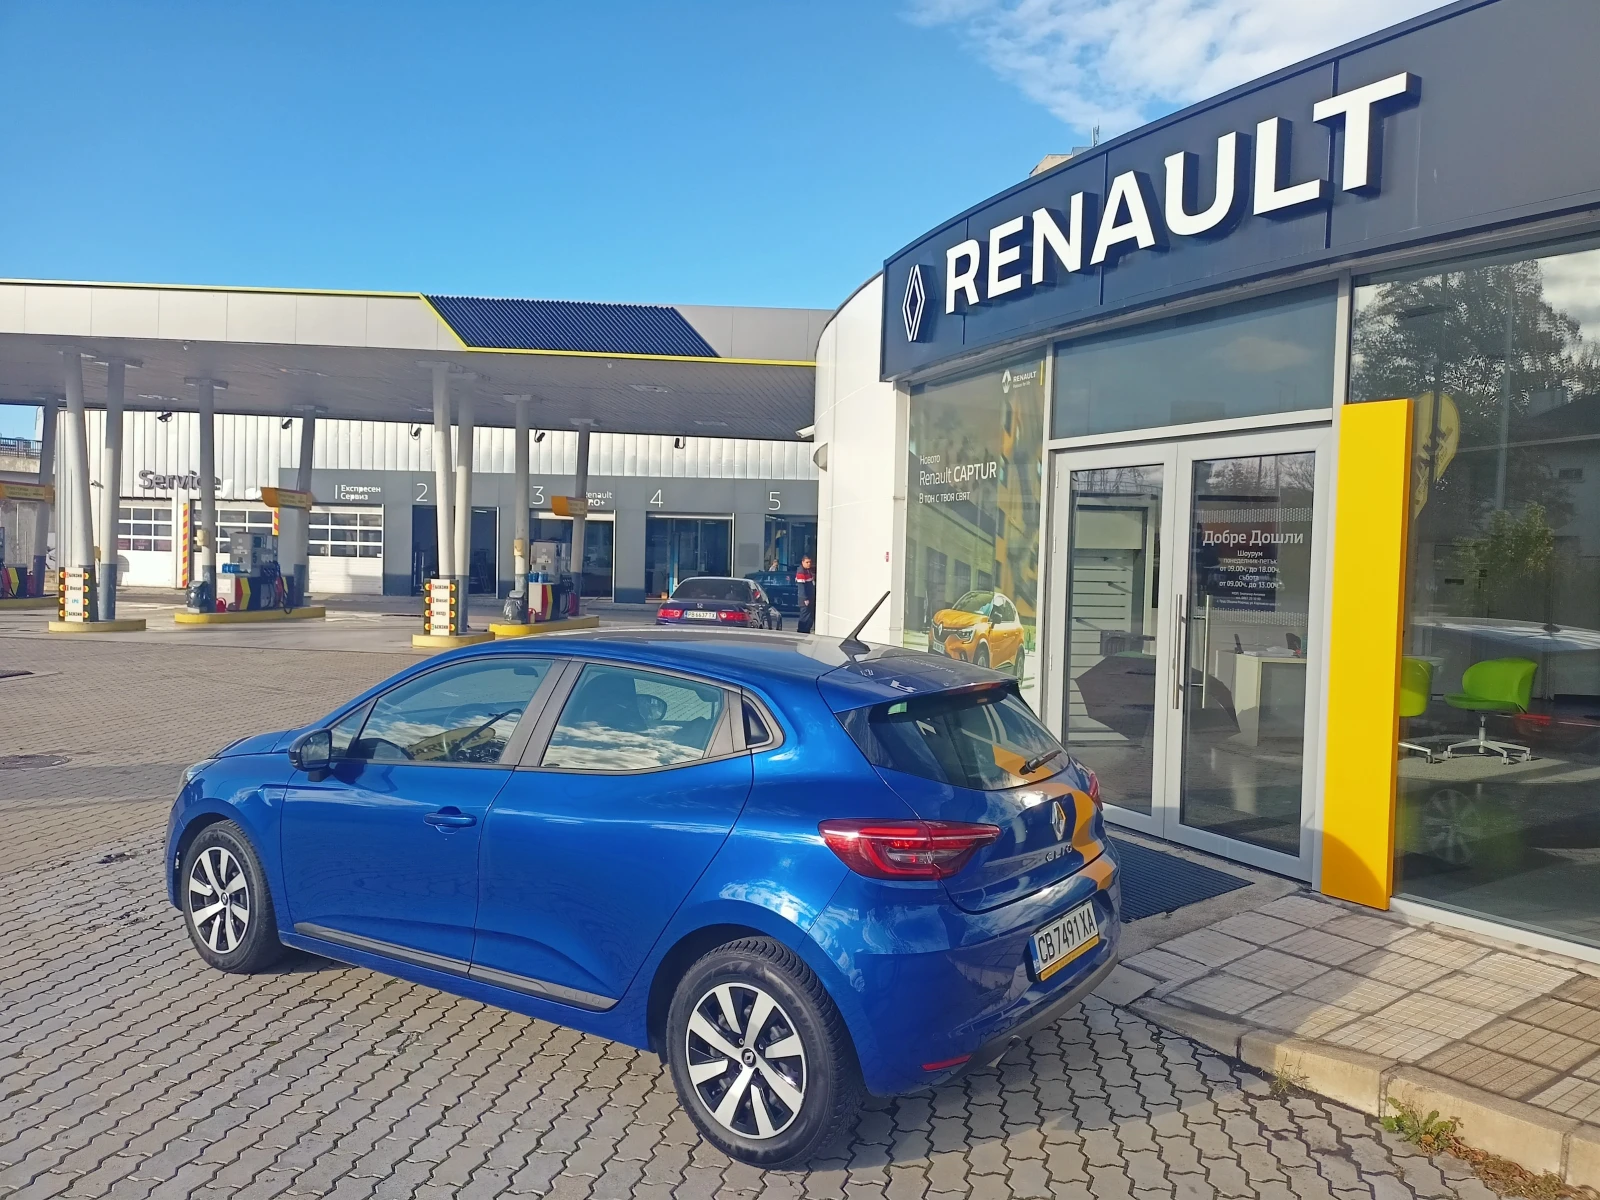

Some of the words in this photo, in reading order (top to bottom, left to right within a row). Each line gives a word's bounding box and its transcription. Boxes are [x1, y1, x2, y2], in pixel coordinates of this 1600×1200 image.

[945, 72, 1409, 315] RENAULT
[1013, 371, 1037, 382] RENAULT
[920, 455, 940, 464] Новото
[920, 467, 951, 485] Renault
[953, 462, 997, 482] CAPTUR
[341, 485, 381, 493] Експресен
[416, 483, 428, 501] 2
[532, 486, 545, 505] 3
[586, 491, 612, 499] enault
[650, 489, 663, 507] 4
[769, 491, 781, 511] 5
[1203, 530, 1247, 547] Добре
[1249, 530, 1303, 546] Дошли
[1046, 845, 1072, 862] CLIO
